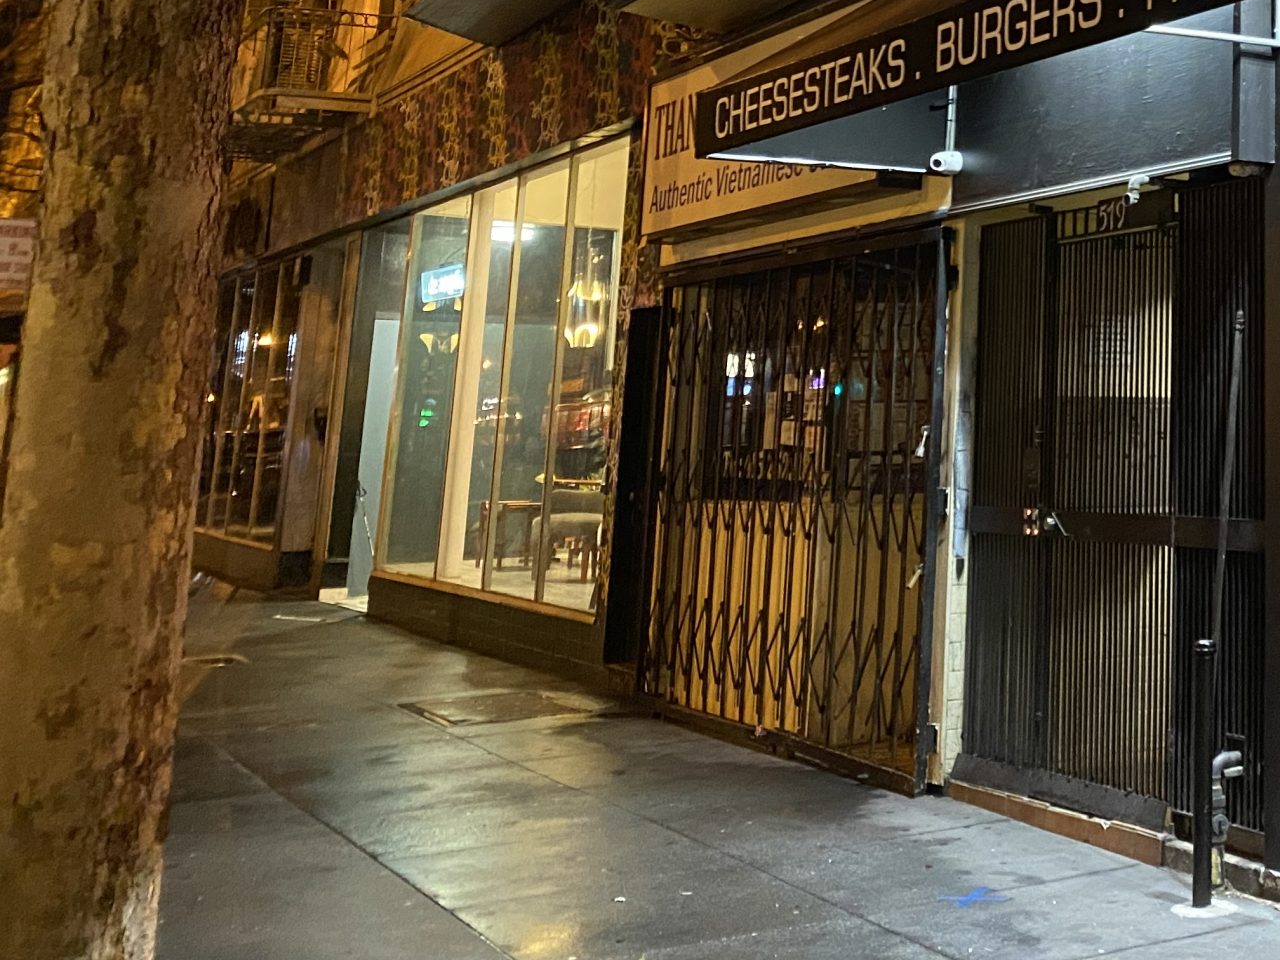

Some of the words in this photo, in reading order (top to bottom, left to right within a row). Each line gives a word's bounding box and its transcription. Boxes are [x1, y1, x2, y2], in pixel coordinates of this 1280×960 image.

[715, 42, 905, 138] CHEESESTEAKS
[650, 173, 711, 214] Authentic
[1100, 197, 1126, 231] 519
